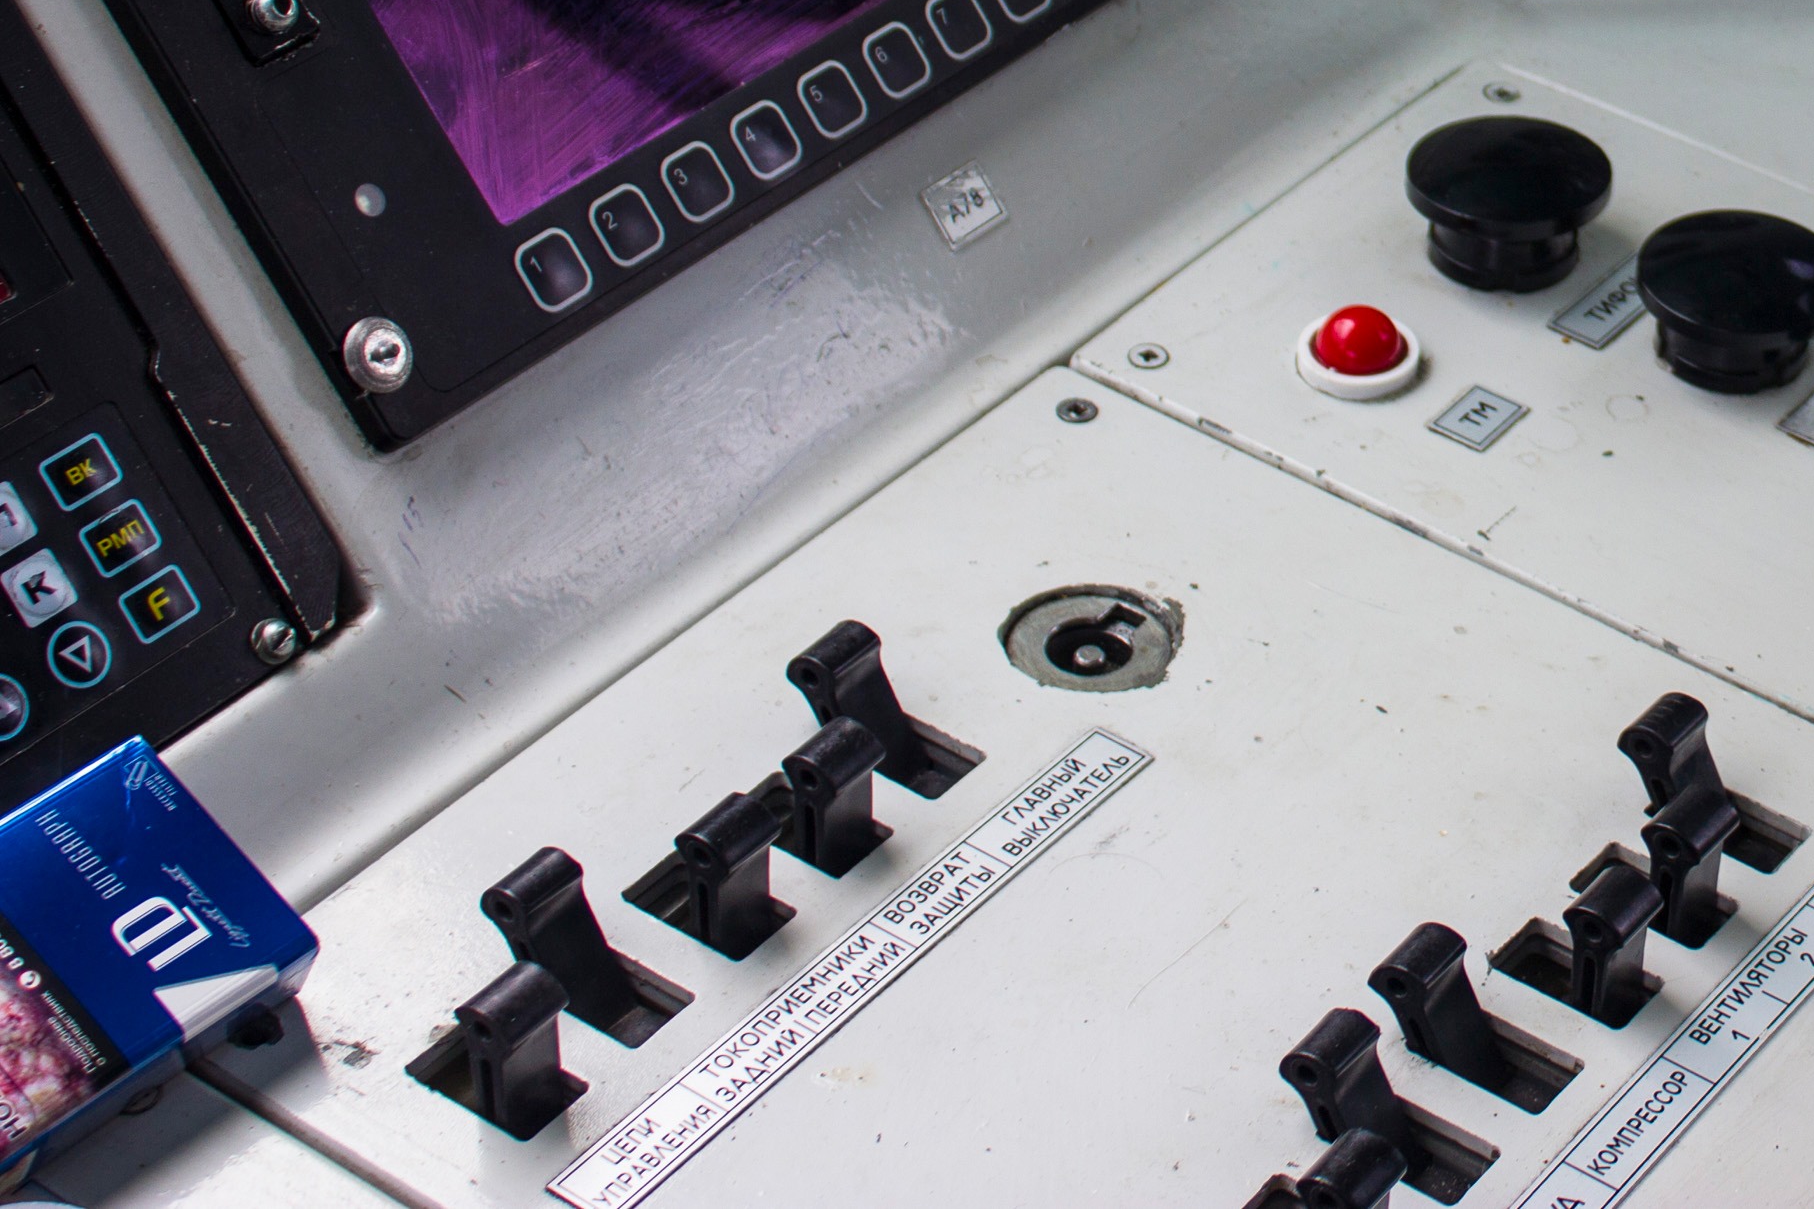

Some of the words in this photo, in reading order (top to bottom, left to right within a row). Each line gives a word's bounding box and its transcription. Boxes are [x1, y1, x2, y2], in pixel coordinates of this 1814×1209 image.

[936, 7, 948, 25] 7
[875, 46, 888, 63] 6
[809, 85, 823, 103] 5
[744, 126, 757, 143] 4
[673, 167, 689, 186] 3
[602, 210, 617, 230] 2
[530, 256, 543, 274] 1
[1583, 276, 1639, 322] ТИФО
[1458, 401, 1498, 426] ТМ
[96, 518, 146, 559] РМП
[147, 586, 171, 621] F
[1001, 757, 1087, 826] ГЛАВНЫЙ
[1001, 753, 1130, 858] ВЫКЛЮЧАТЕЛЬ
[35, 809, 126, 900] AUTOGRAPH
[883, 851, 972, 925] ВОЗВРАТ
[909, 865, 996, 936] ЗАЩИТЫ
[111, 895, 212, 972] LD
[699, 934, 876, 1079] ТОКОПРИЕМНИКИ
[1688, 927, 1809, 1046] ВЕНТИЛЯТОРЫ
[47, 1016, 97, 1075] Подробнее
[715, 1028, 805, 1102] ЗАДНИЙ
[804, 941, 906, 1027] ПЕРЕДНИЙ
[1730, 1028, 1751, 1041] 1
[601, 1116, 661, 1166] ЦЕПИ
[1586, 1070, 1689, 1176] КОМПРЕССОР
[592, 1104, 718, 1207] УПРАВЛЕНИЯ
